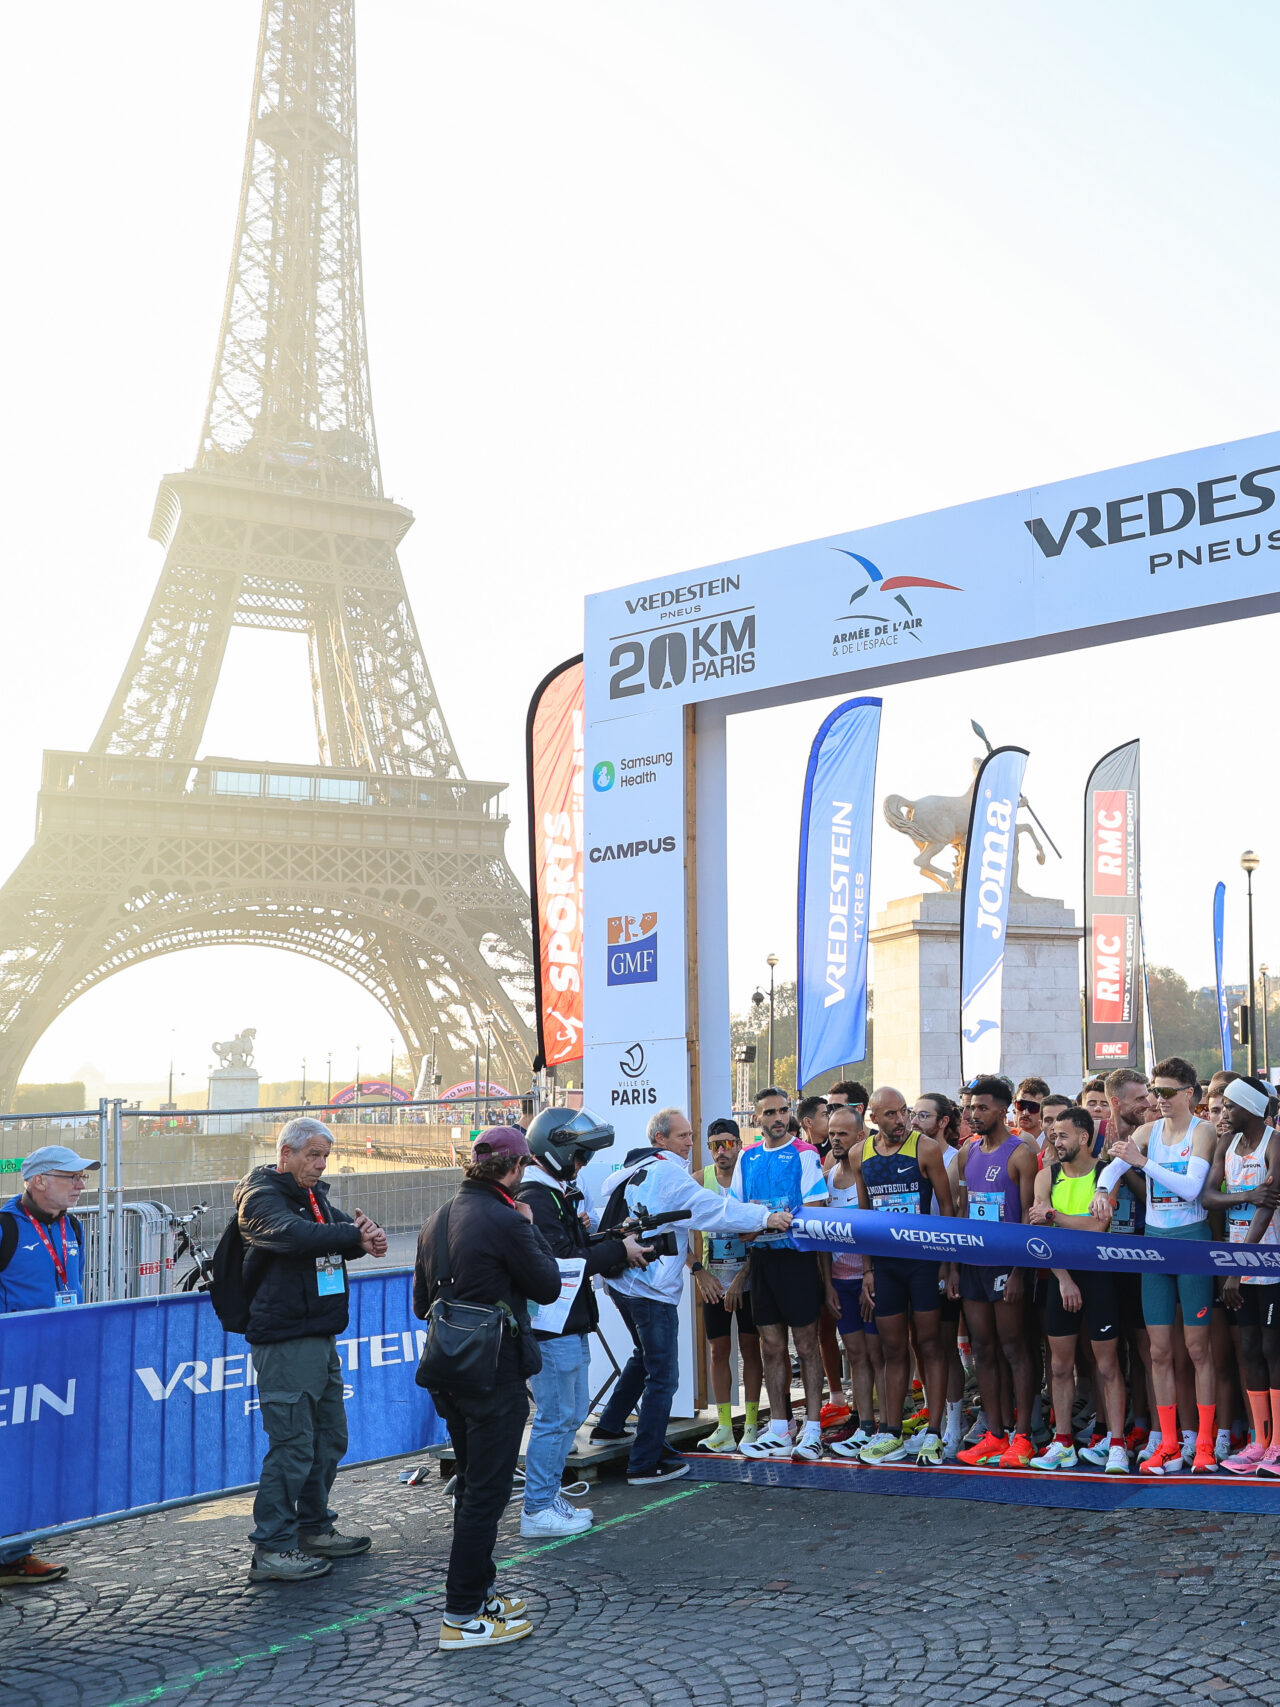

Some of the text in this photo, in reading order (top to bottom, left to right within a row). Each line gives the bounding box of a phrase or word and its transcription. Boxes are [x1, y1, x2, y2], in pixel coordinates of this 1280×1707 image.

[625, 574, 740, 614] VREDESTEIN
[660, 605, 701, 620] PNEUS
[833, 618, 923, 645] ARMÉE DE L'AIR
[832, 636, 898, 657] & DE L'ESPACE
[609, 615, 755, 700] 20 KM
[693, 652, 755, 683] PARIS
[620, 752, 673, 770] Samsung
[620, 771, 656, 788] Health
[589, 836, 676, 863] CAMPUS
[1098, 809, 1123, 876] RMC
[1126, 792, 1135, 895] INFO TALK SPORT
[544, 810, 581, 993] SPORTS
[824, 801, 853, 1009] VREDESTEIN
[854, 872, 865, 942] TYRES
[611, 950, 654, 975] GMF
[1096, 934, 1121, 1002] RMC
[1122, 917, 1134, 1021] INFO TALK SPORT
[1102, 1044, 1122, 1054] RMC
[618, 1080, 639, 1088] VILLE
[612, 1088, 657, 1107] PARIS
[870, 1184, 909, 1195] MONTREUIL
[910, 1182, 919, 1192] 93
[978, 1206, 985, 1216] 6
[824, 1221, 852, 1237] KM
[828, 1235, 856, 1244] PARIS
[890, 1228, 984, 1247] VREDESTEIN
[724, 1242, 732, 1251] 4
[1210, 1251, 1260, 1267] 20
